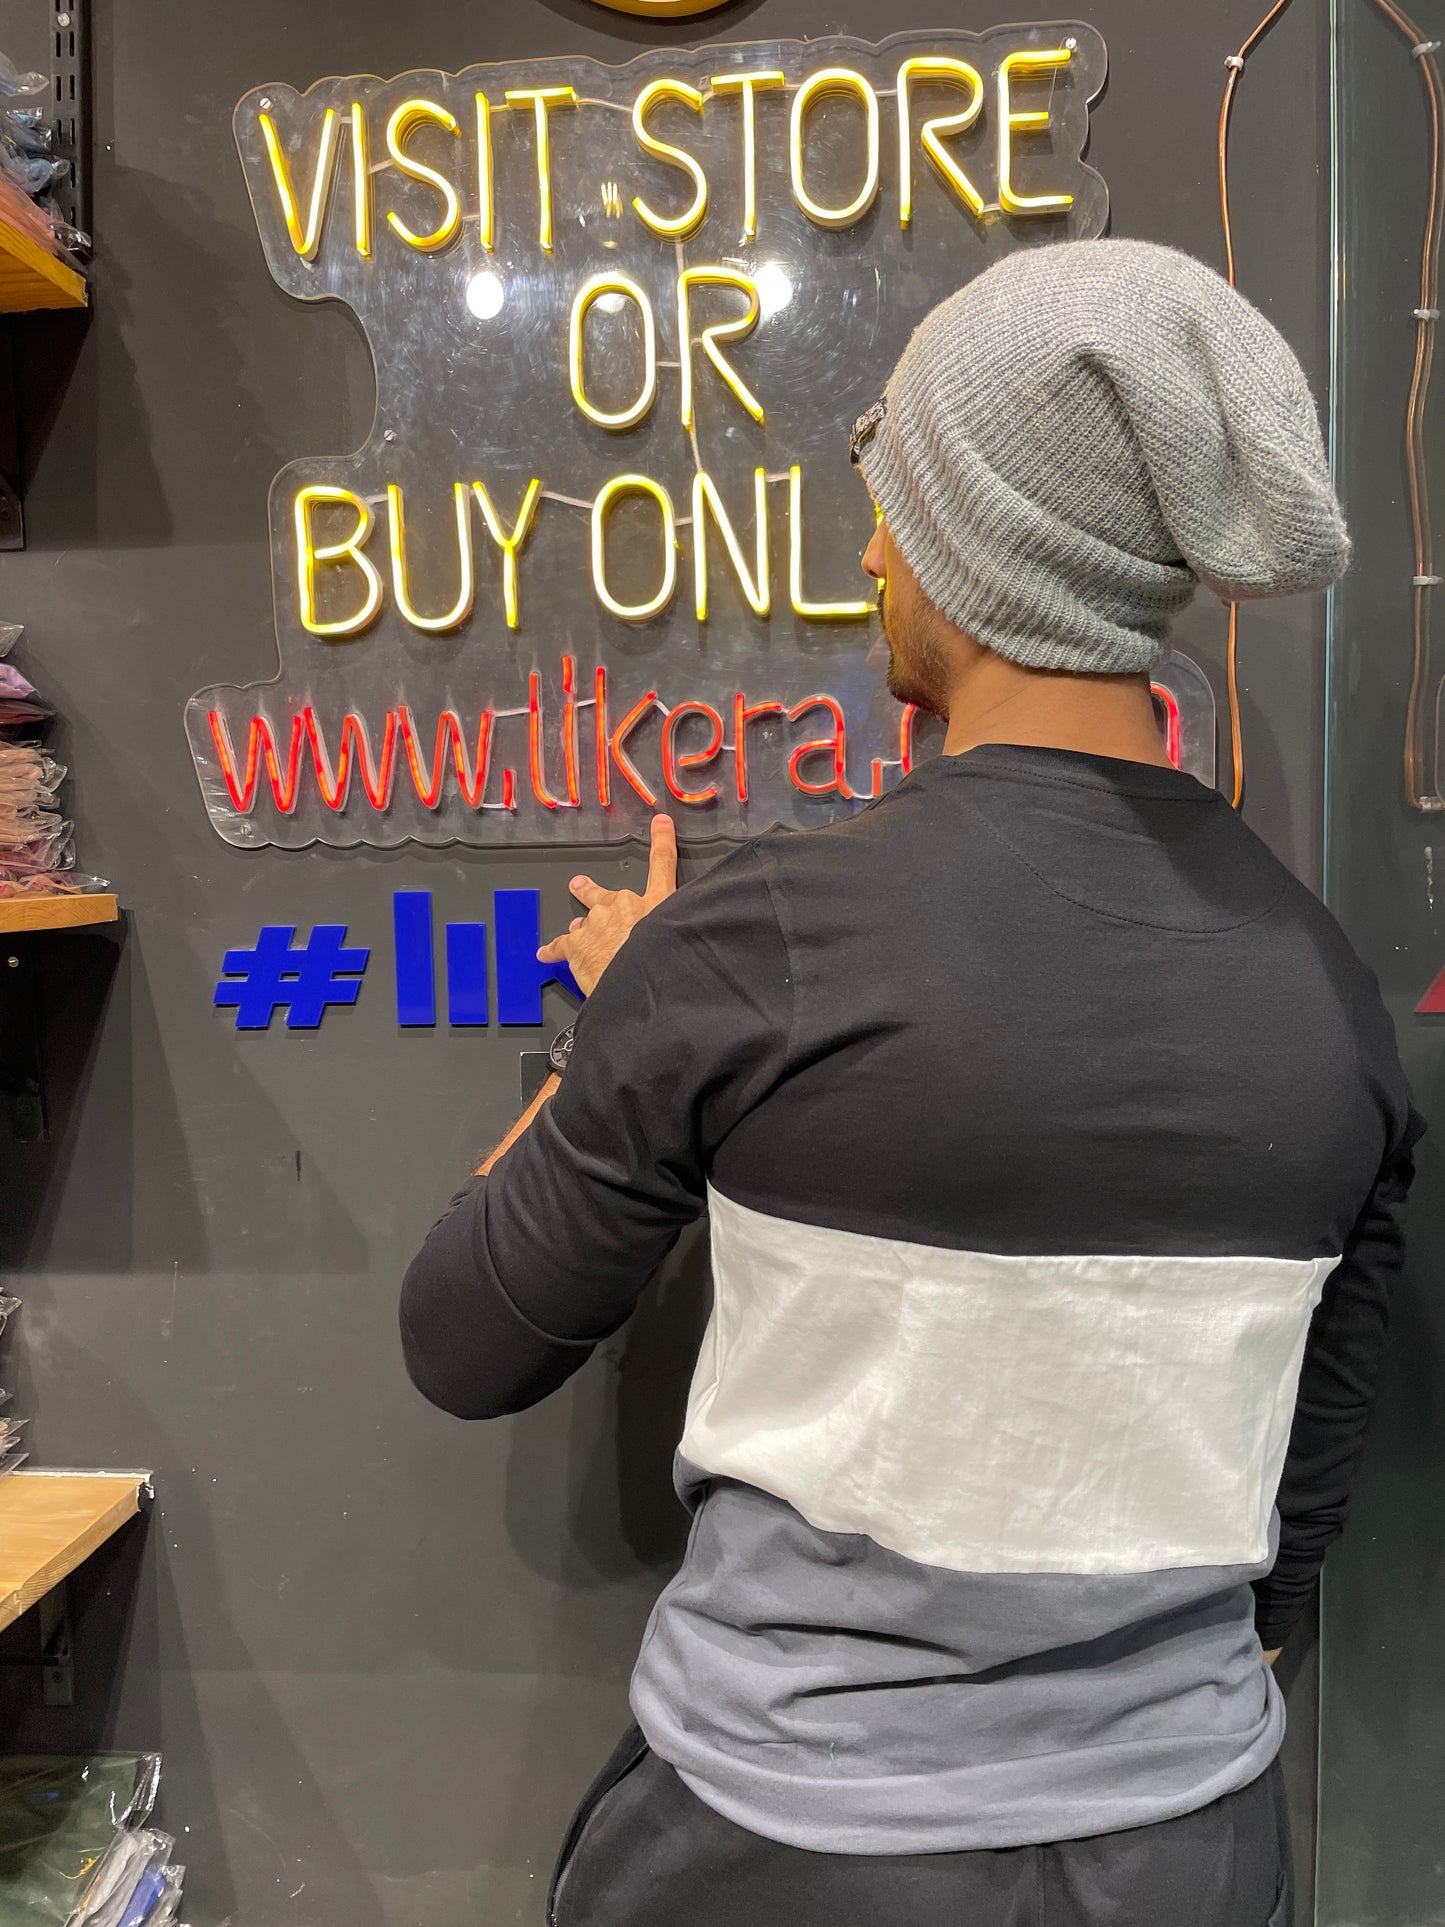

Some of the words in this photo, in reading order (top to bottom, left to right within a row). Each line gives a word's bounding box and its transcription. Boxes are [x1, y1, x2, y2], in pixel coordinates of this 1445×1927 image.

[258, 86, 579, 259] VISIT
[631, 49, 1075, 240] STORE
[569, 265, 766, 431] OR
[293, 477, 542, 637] BUY
[589, 464, 885, 621] ONL
[207, 654, 1182, 814] www.likera.
[213, 888, 587, 1030] #lik
